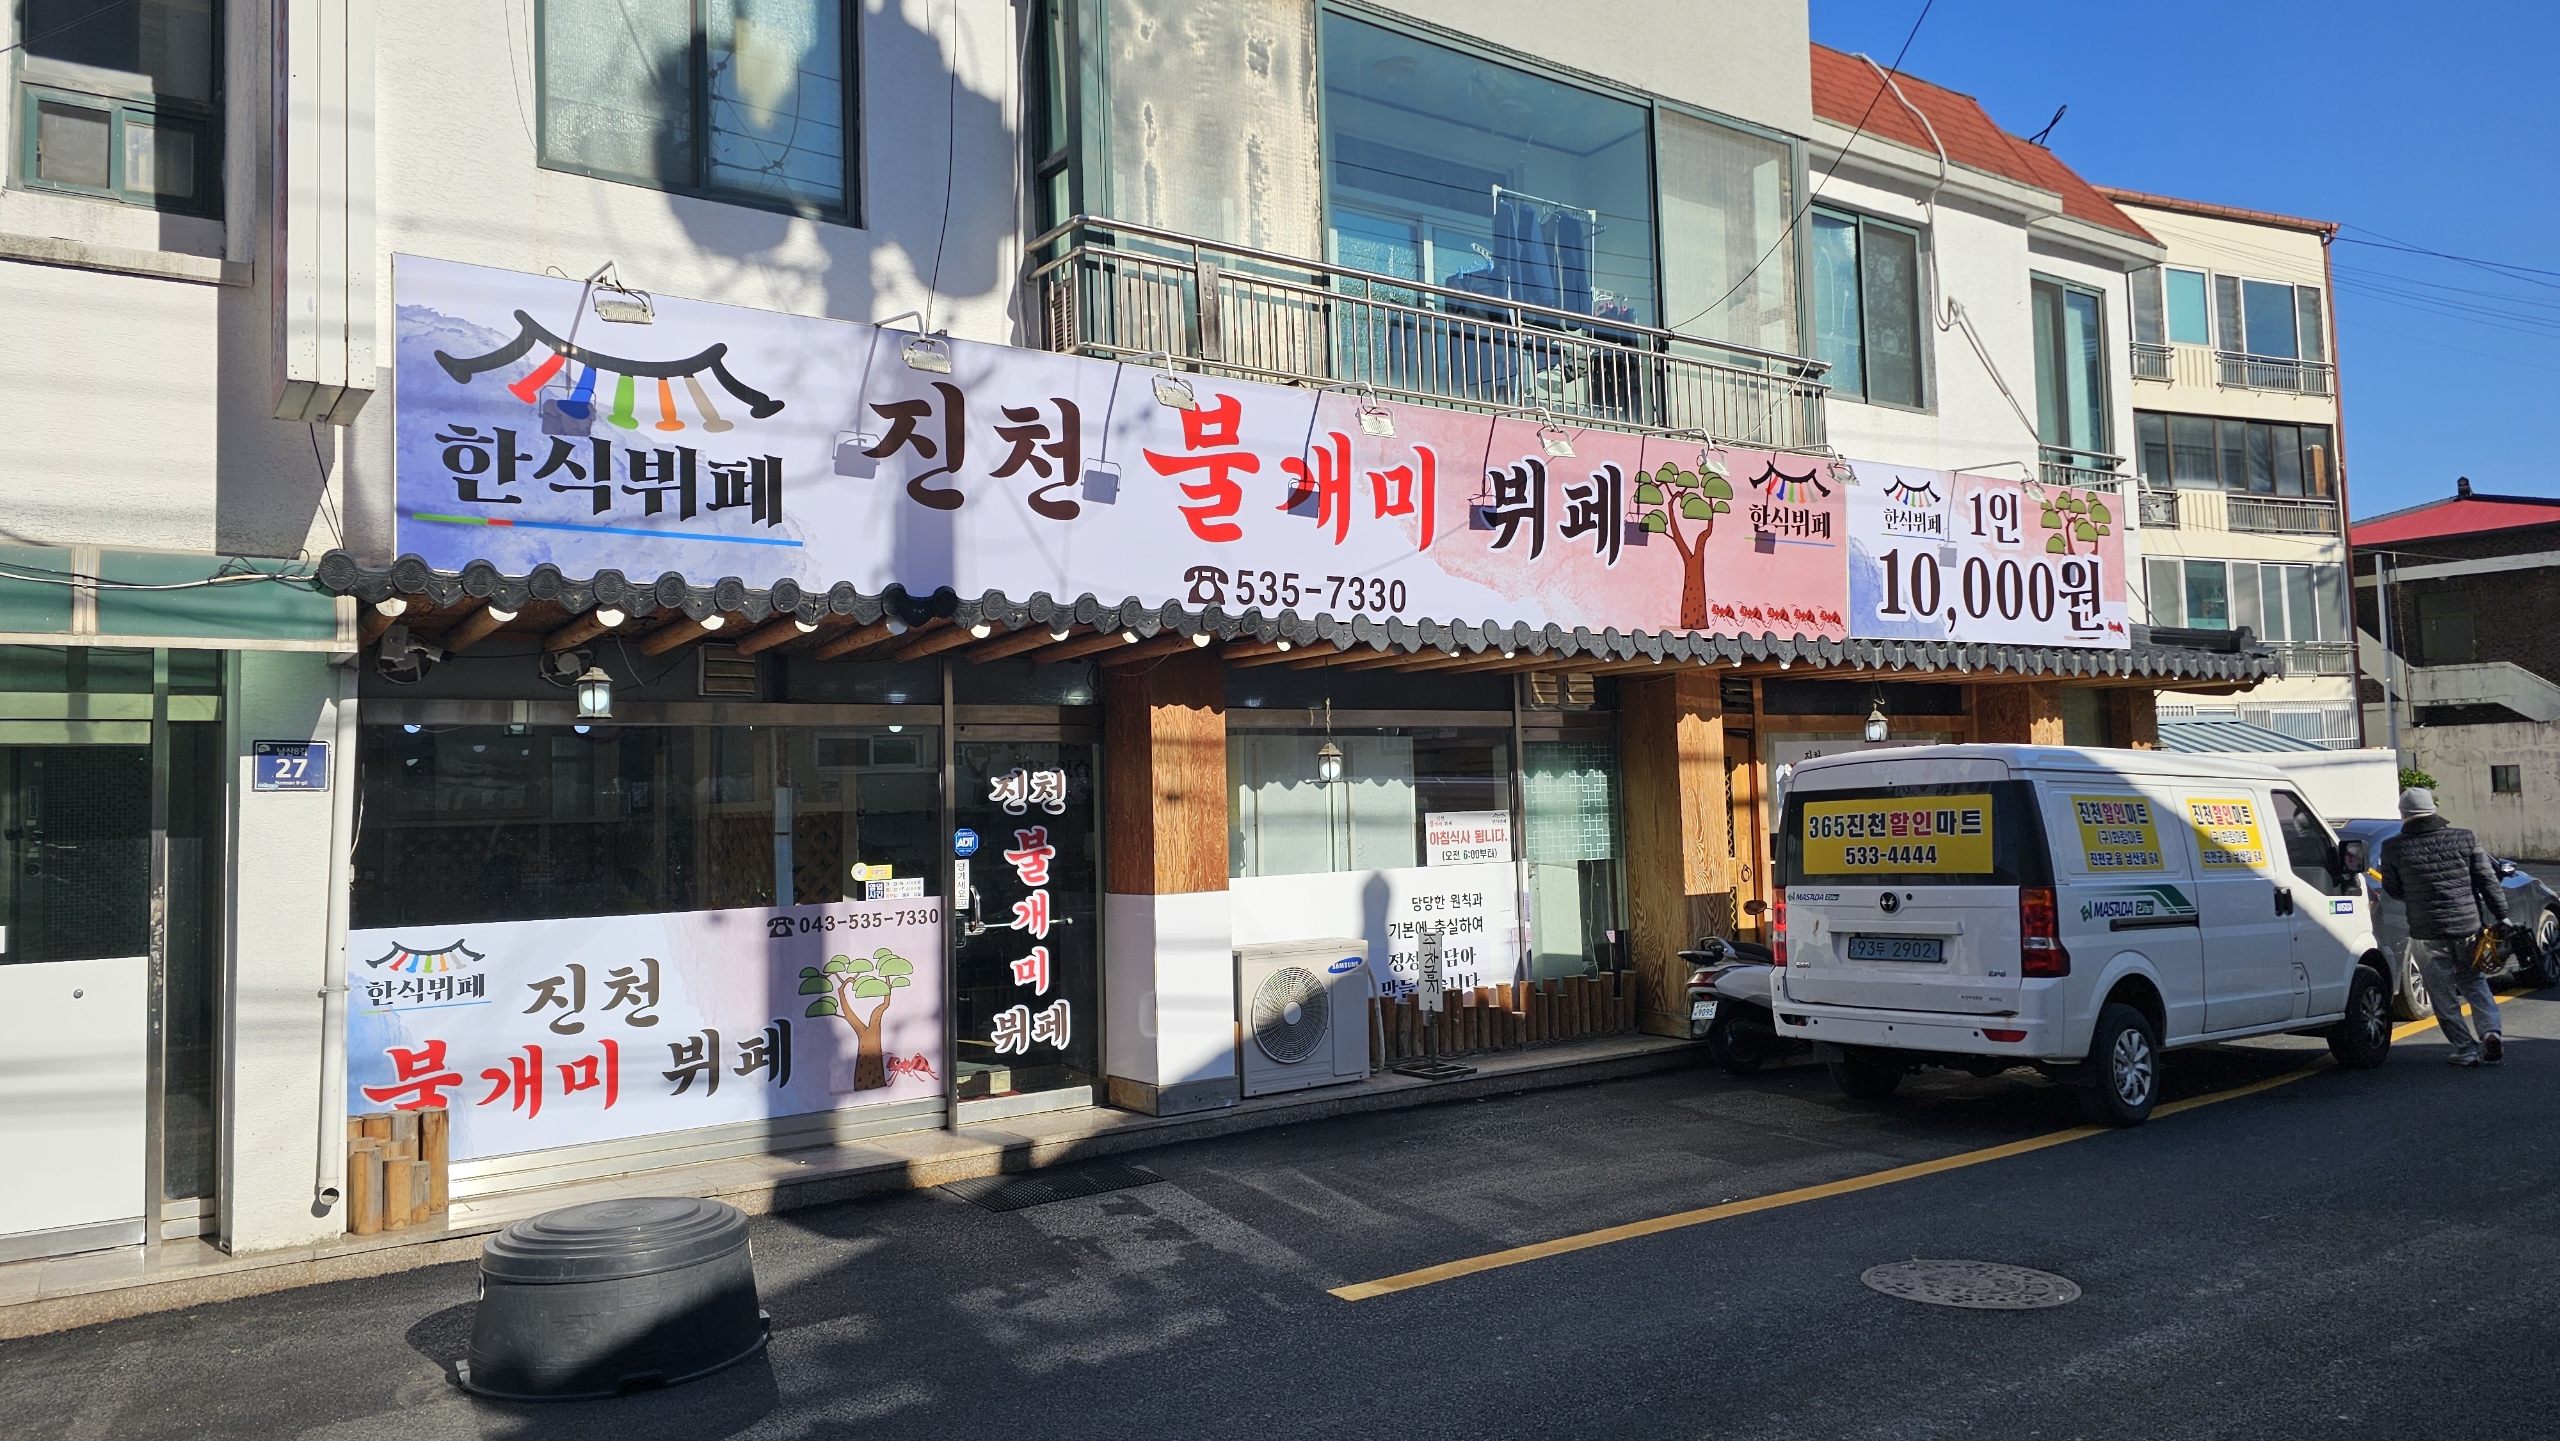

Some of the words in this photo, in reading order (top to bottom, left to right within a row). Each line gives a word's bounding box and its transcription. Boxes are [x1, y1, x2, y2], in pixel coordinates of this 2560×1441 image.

[435, 423, 784, 528] 한식뷔페
[862, 381, 1081, 521] 진천
[1143, 393, 1436, 552] 불개미
[1481, 459, 1620, 566] 뷔페
[1749, 502, 1831, 540] 한식뷔페
[1884, 508, 1941, 534] 한식뷔페
[1970, 493, 2019, 543] 1인
[1236, 570, 1406, 613] 535-7330
[1880, 547, 2103, 633] 10,000원
[277, 747, 308, 757] 남산8길
[275, 758, 308, 778] 27
[990, 768, 1066, 815] 진천
[1808, 809, 1983, 839] 365진천할인마트
[2076, 801, 2149, 825] 진천할인마트
[2191, 804, 2253, 826] 진천할인마트
[956, 836, 974, 848] ADT
[1429, 830, 1470, 846] 아침식사
[2097, 829, 2145, 846] (구)화랑마트
[1442, 850, 1460, 861] (오전
[1463, 848, 1498, 860] 6:00부터)
[1845, 845, 1938, 865] 533-4444
[2125, 852, 2147, 866] 남산길
[957, 862, 966, 898] 당기세요
[868, 890, 883, 899] 시간
[1411, 895, 1446, 912] 당당한
[1450, 892, 1483, 909] 원칙과
[1796, 893, 1824, 901] MASADA
[799, 908, 940, 933] 043-535-7330
[1005, 826, 1055, 994] 불개미
[2094, 901, 2133, 917] MASADA
[1388, 920, 1427, 940] 기본에
[1434, 915, 1484, 936] 충실하여
[1443, 946, 1477, 968] 담아
[1857, 940, 1885, 958] 93두
[1892, 942, 1932, 958] 2902
[1422, 933, 1440, 995] 주차금지
[366, 973, 486, 1006] 한식뷔페
[523, 957, 660, 1035] 진천
[992, 999, 1070, 1054] 뷔페
[662, 1018, 792, 1098] 뷔페
